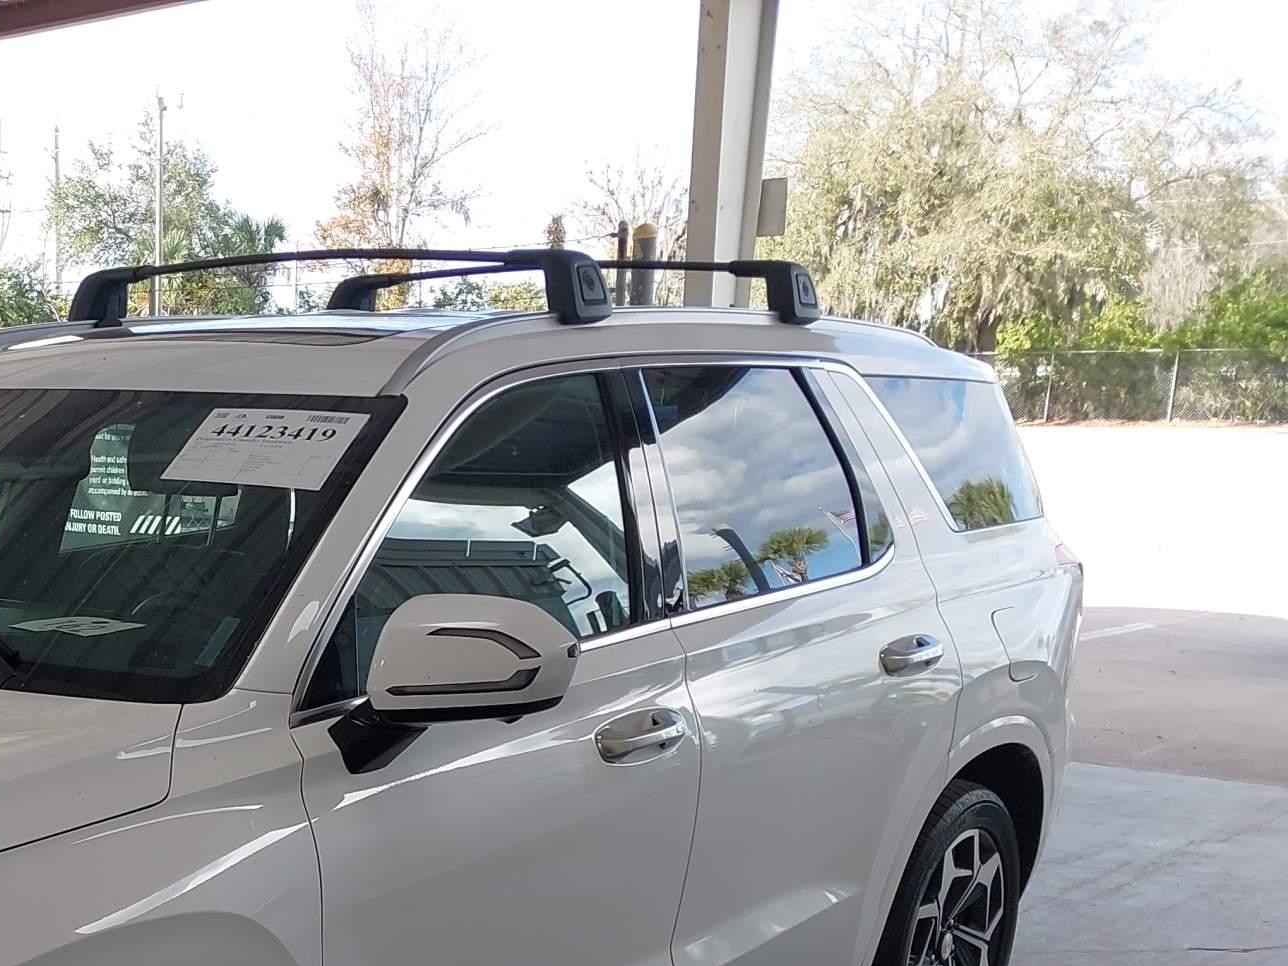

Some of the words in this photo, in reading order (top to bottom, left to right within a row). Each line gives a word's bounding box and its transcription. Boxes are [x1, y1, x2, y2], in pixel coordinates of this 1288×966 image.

[211, 423, 337, 442] 44123419
[116, 456, 127, 464] safe
[70, 508, 95, 520] FOLLOW
[96, 511, 122, 522] POSTED
[87, 524, 97, 534] OR
[98, 524, 122, 536] DEATH.
